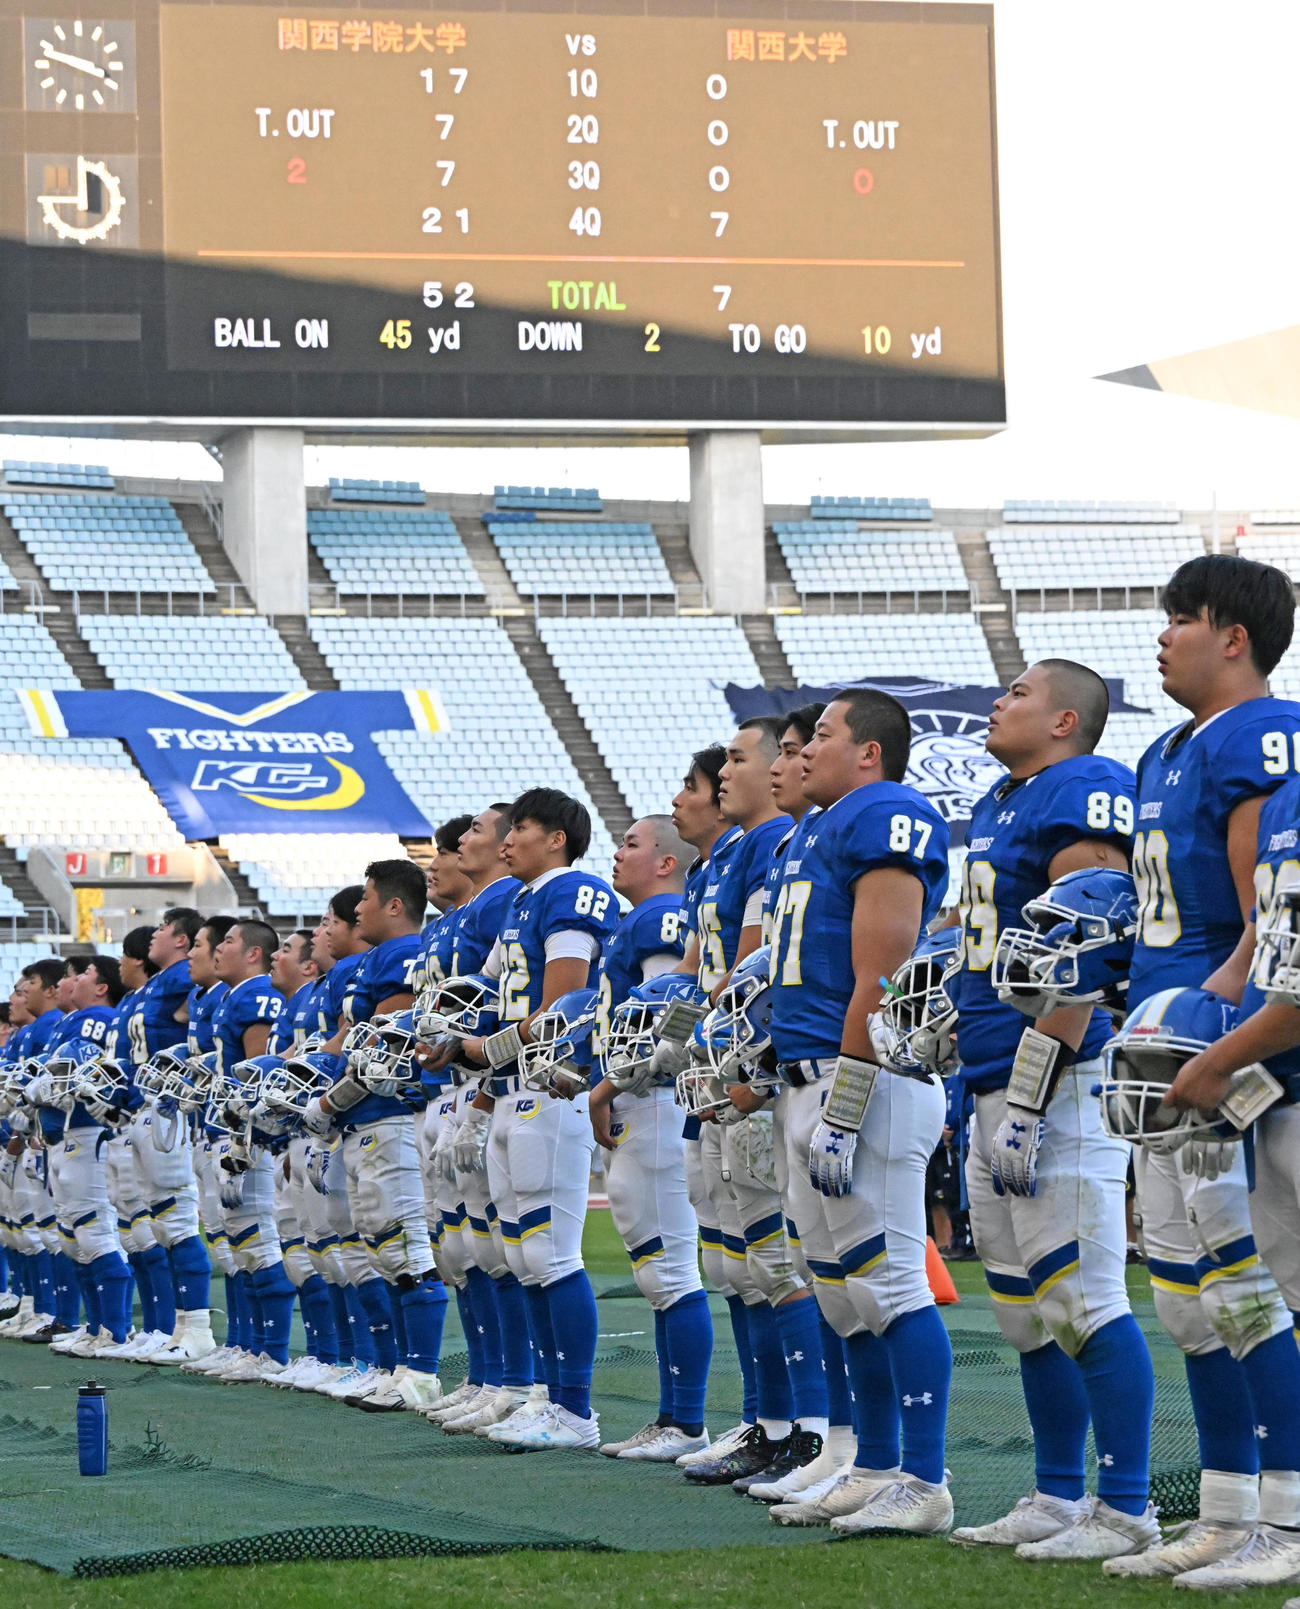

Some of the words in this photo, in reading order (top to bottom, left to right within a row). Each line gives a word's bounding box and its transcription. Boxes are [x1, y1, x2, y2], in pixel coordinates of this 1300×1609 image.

[278, 18, 467, 55] 関西学院大学
[726, 29, 848, 63] 関西大学
[567, 68, 598, 98] 1Q
[435, 114, 455, 140] 7
[567, 114, 600, 145] 2Q
[287, 157, 308, 185] 2
[436, 161, 457, 187] 7
[568, 161, 601, 191] 3Q
[569, 207, 602, 237] 4Q
[710, 211, 730, 238] 7
[547, 280, 626, 311] TOTAL
[712, 285, 733, 311] 7
[214, 318, 281, 349] BALL
[294, 318, 329, 350] ON
[379, 319, 412, 350] 45
[428, 320, 462, 355] yd
[518, 321, 584, 352] DOWN
[644, 323, 662, 353] 2
[729, 324, 761, 354] TO
[774, 324, 808, 354] GO
[862, 326, 893, 356] 10
[911, 326, 943, 359] yd
[147, 728, 354, 754] FIGHTERS
[190, 759, 329, 794] KG
[1086, 791, 1134, 836] 89
[889, 814, 933, 860] 87
[67, 854, 83, 874] J
[575, 885, 610, 922] 82
[255, 995, 282, 1018] 73
[81, 1018, 106, 1040] 68
